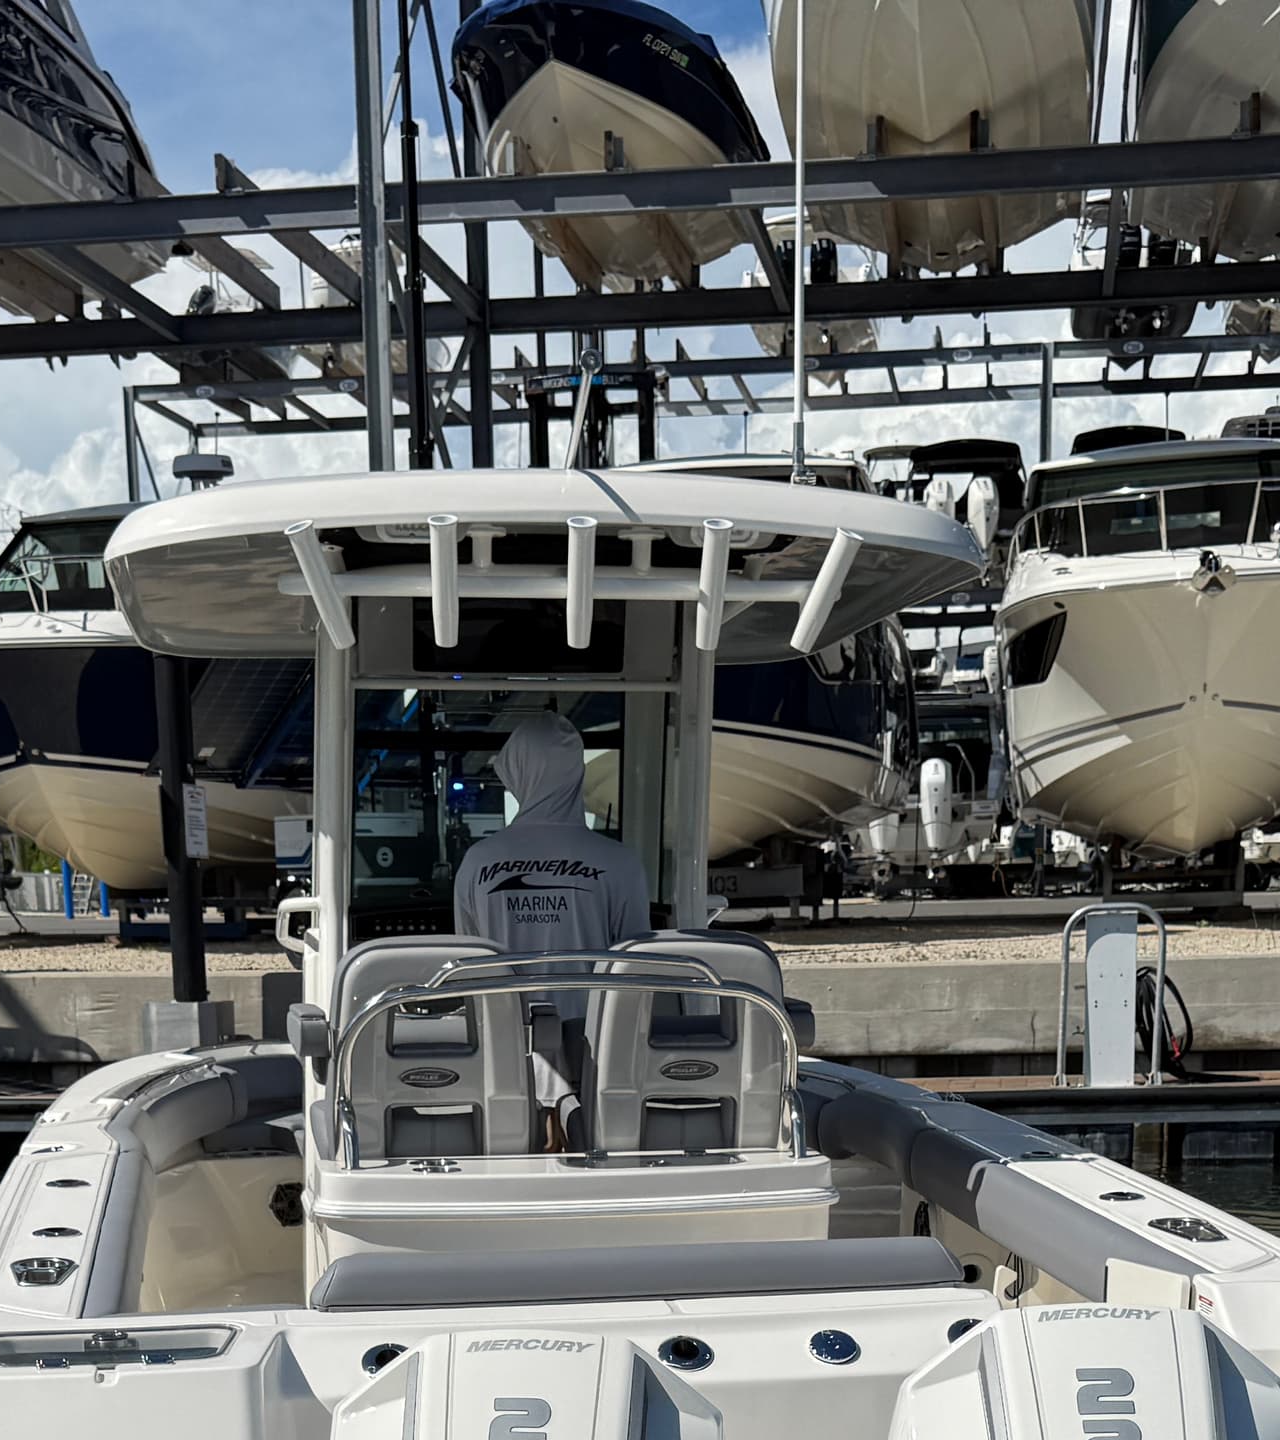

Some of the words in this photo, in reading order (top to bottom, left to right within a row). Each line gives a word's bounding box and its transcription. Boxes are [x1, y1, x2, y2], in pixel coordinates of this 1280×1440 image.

[642, 33, 654, 47] FL
[507, 895, 569, 912] MARINA
[515, 913, 561, 924] SARASOTA
[1037, 1307, 1162, 1323] MERCURY
[465, 1339, 596, 1353] MERCURY
